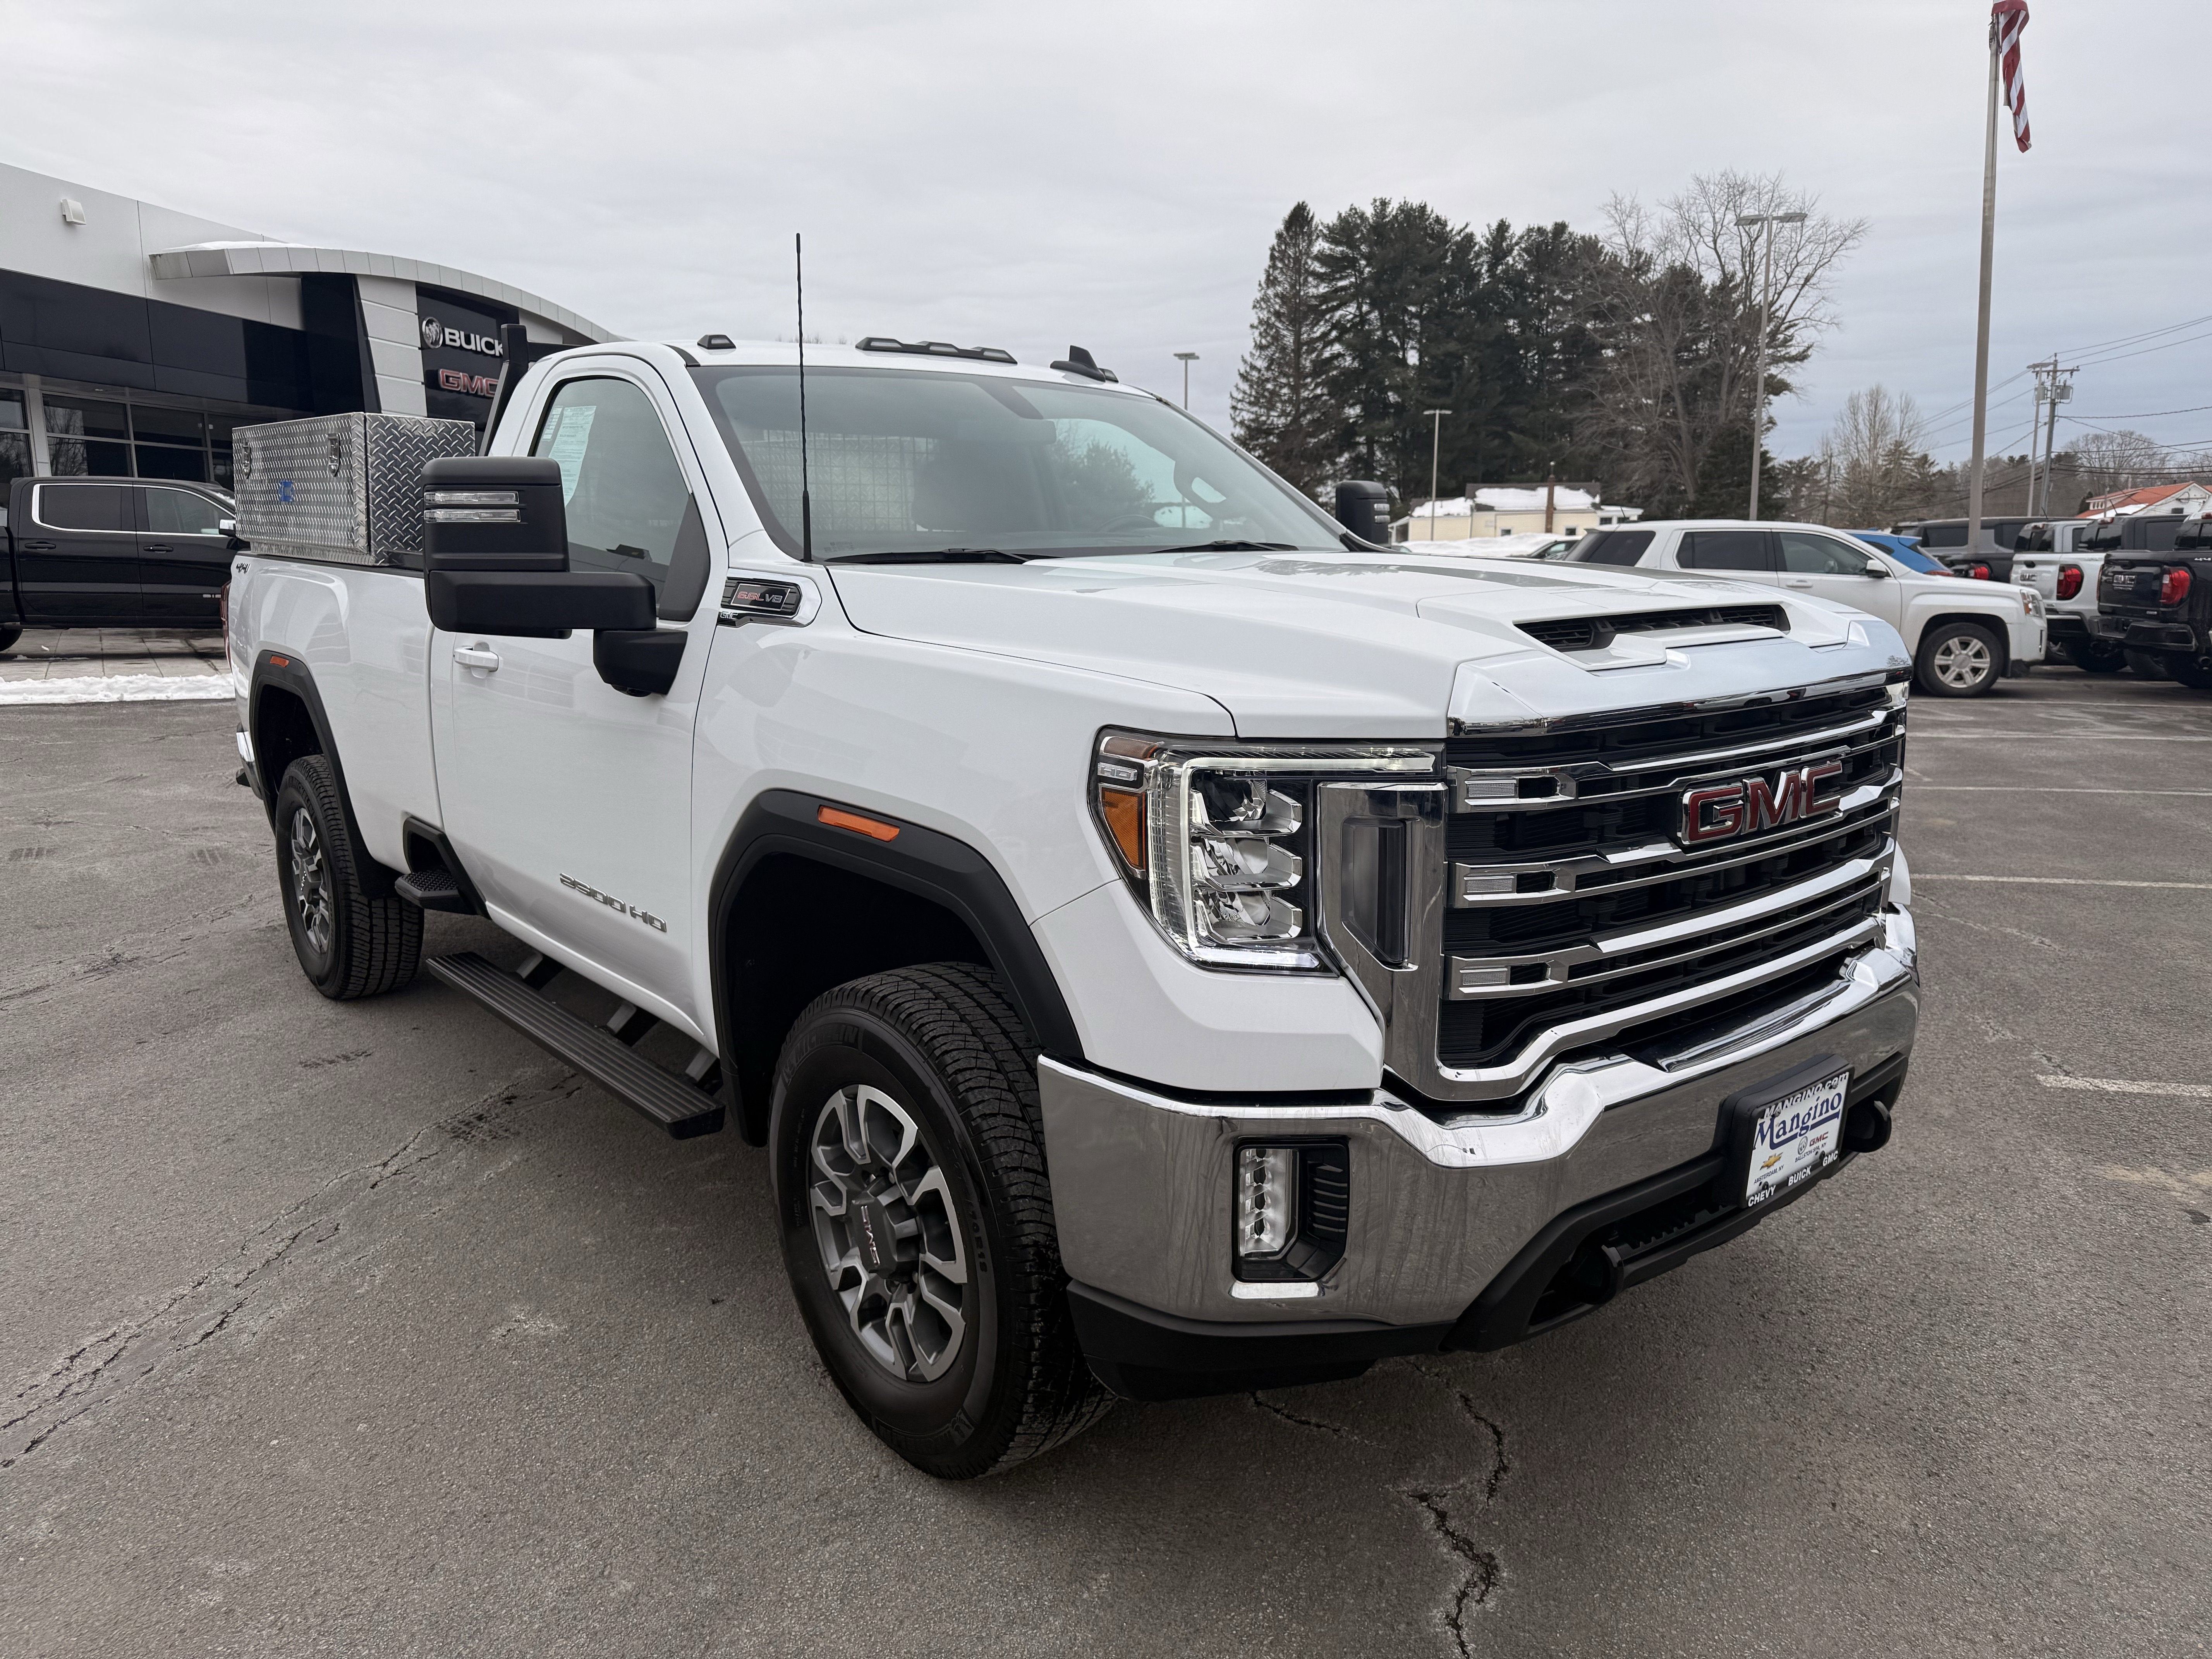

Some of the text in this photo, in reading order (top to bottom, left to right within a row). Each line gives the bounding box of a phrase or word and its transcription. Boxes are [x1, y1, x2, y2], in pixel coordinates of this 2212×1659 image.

[445, 327, 503, 356] BUICK
[438, 369, 499, 397] GMC
[737, 591, 783, 603] 6.6L V8
[1679, 760, 1843, 846] GMC
[560, 873, 667, 933] 2500 HD
[1753, 1092, 1842, 1150] Mangino
[1810, 1131, 1829, 1147] GMC
[1748, 1150, 1838, 1207] CHEVY BUICK GMC
